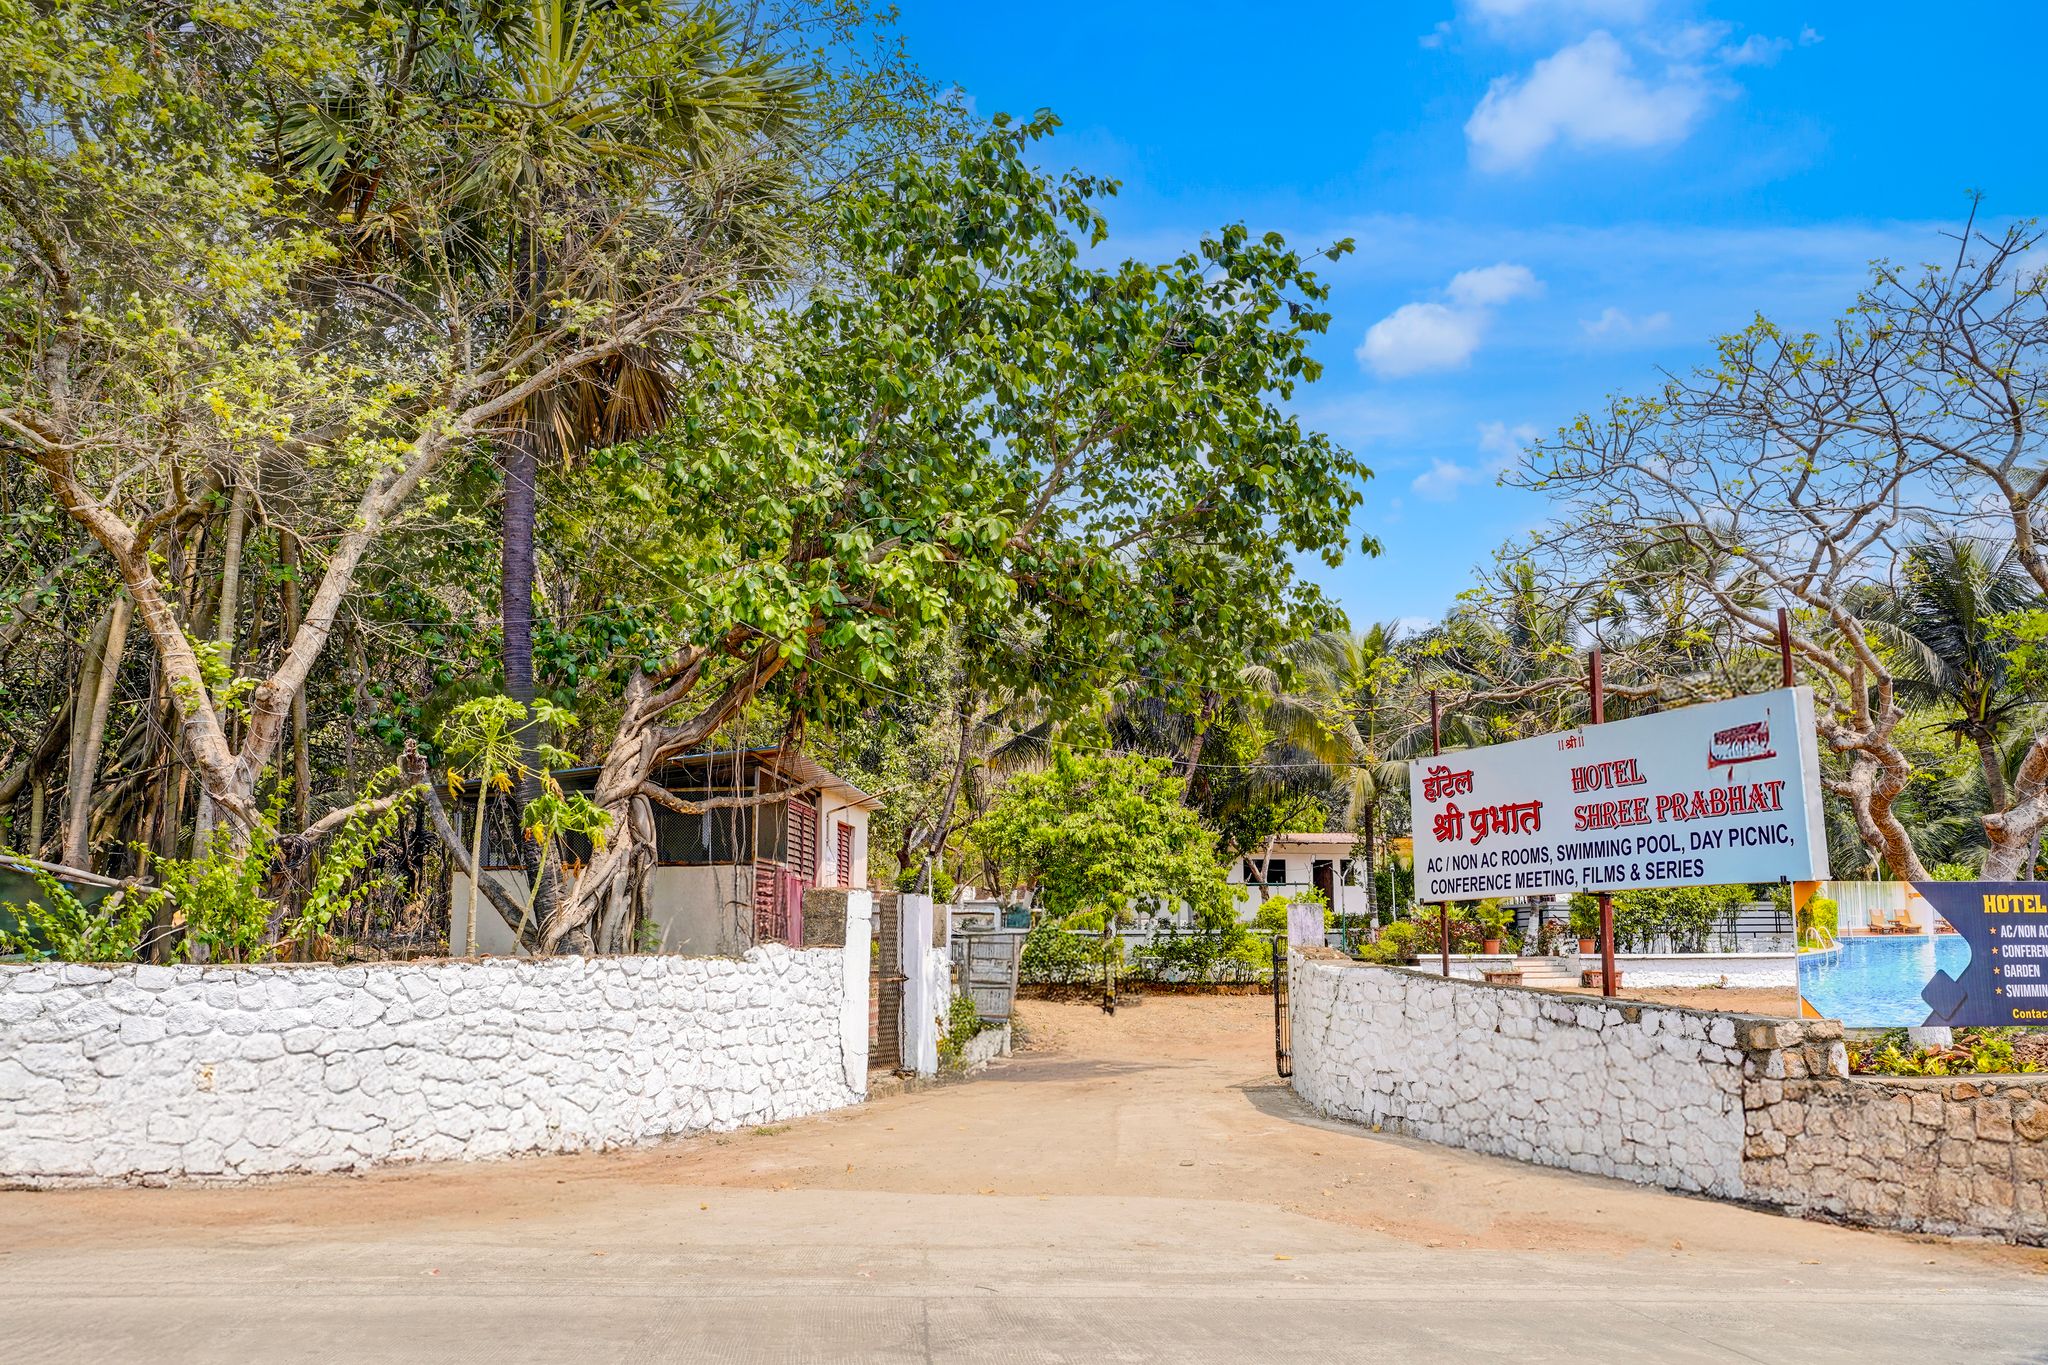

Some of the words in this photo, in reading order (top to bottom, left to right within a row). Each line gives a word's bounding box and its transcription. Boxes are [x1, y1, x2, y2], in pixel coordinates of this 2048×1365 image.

[1422, 765, 1474, 802] हॉटेल
[1571, 758, 1647, 793] HOTEL
[1433, 802, 1464, 843] श्री
[1469, 800, 1543, 845] प्रभात
[1574, 797, 1652, 831] SHREE
[1656, 780, 1785, 822] PRABHAT
[1427, 857, 1443, 873] AC
[1452, 854, 1478, 871] NON
[1481, 851, 1498, 868] AC
[1502, 846, 1553, 866] ROOMS,
[1556, 838, 1632, 862] SWIMMING
[1636, 834, 1685, 855] POOL,
[1690, 829, 1724, 851] DAY
[1728, 823, 1794, 848] PICNIC,
[1430, 873, 1512, 895] CONFERENCE
[1515, 868, 1578, 889] MEETING,
[1582, 864, 1626, 884] FILMS
[1630, 863, 1641, 881] &
[1645, 859, 1704, 880] SERIES
[1983, 894, 2048, 914] HOTEL
[2000, 925, 2037, 938] AC/NON
[2004, 964, 2041, 978] GARDEN
